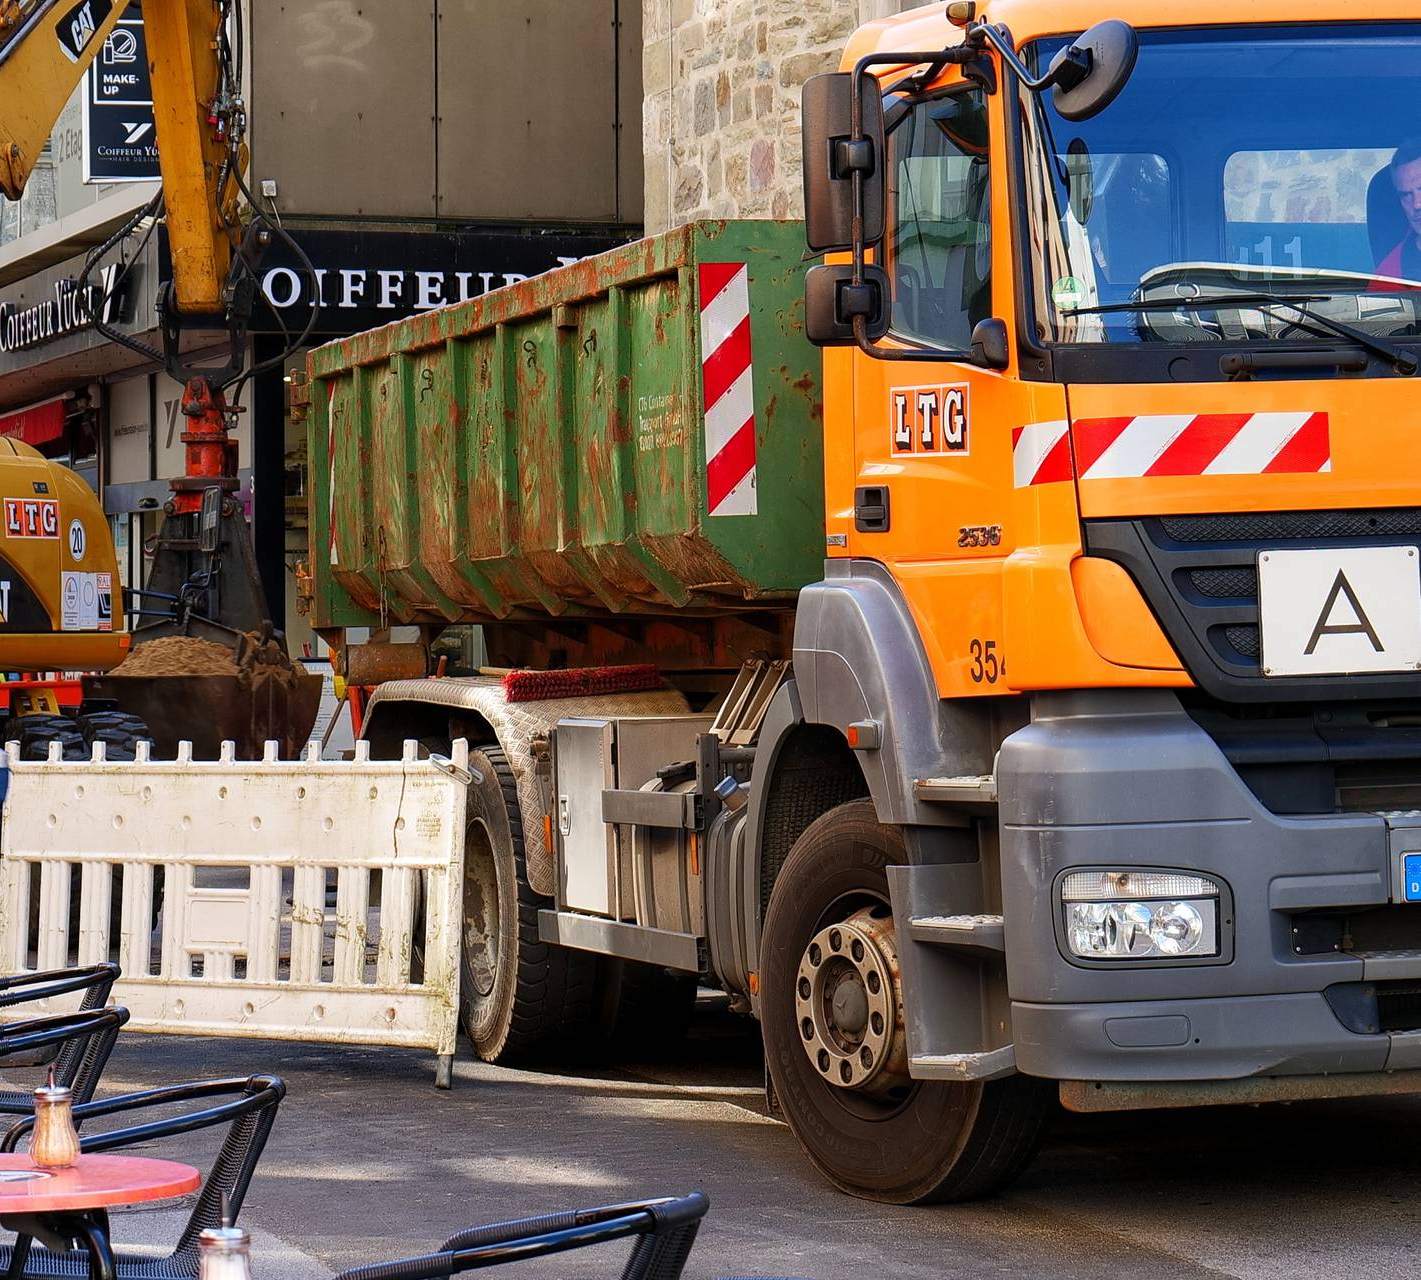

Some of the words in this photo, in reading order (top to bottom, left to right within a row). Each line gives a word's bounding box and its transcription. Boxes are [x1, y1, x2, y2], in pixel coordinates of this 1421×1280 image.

[71, 3, 96, 51] CAT
[103, 74, 140, 84] MAKE-
[103, 86, 119, 95] UP
[895, 388, 967, 451] LTG
[7, 503, 56, 535] LTG
[72, 527, 83, 554] 20
[958, 526, 1002, 548] 2536
[1303, 567, 1385, 655] A
[1412, 882, 1420, 892] D
